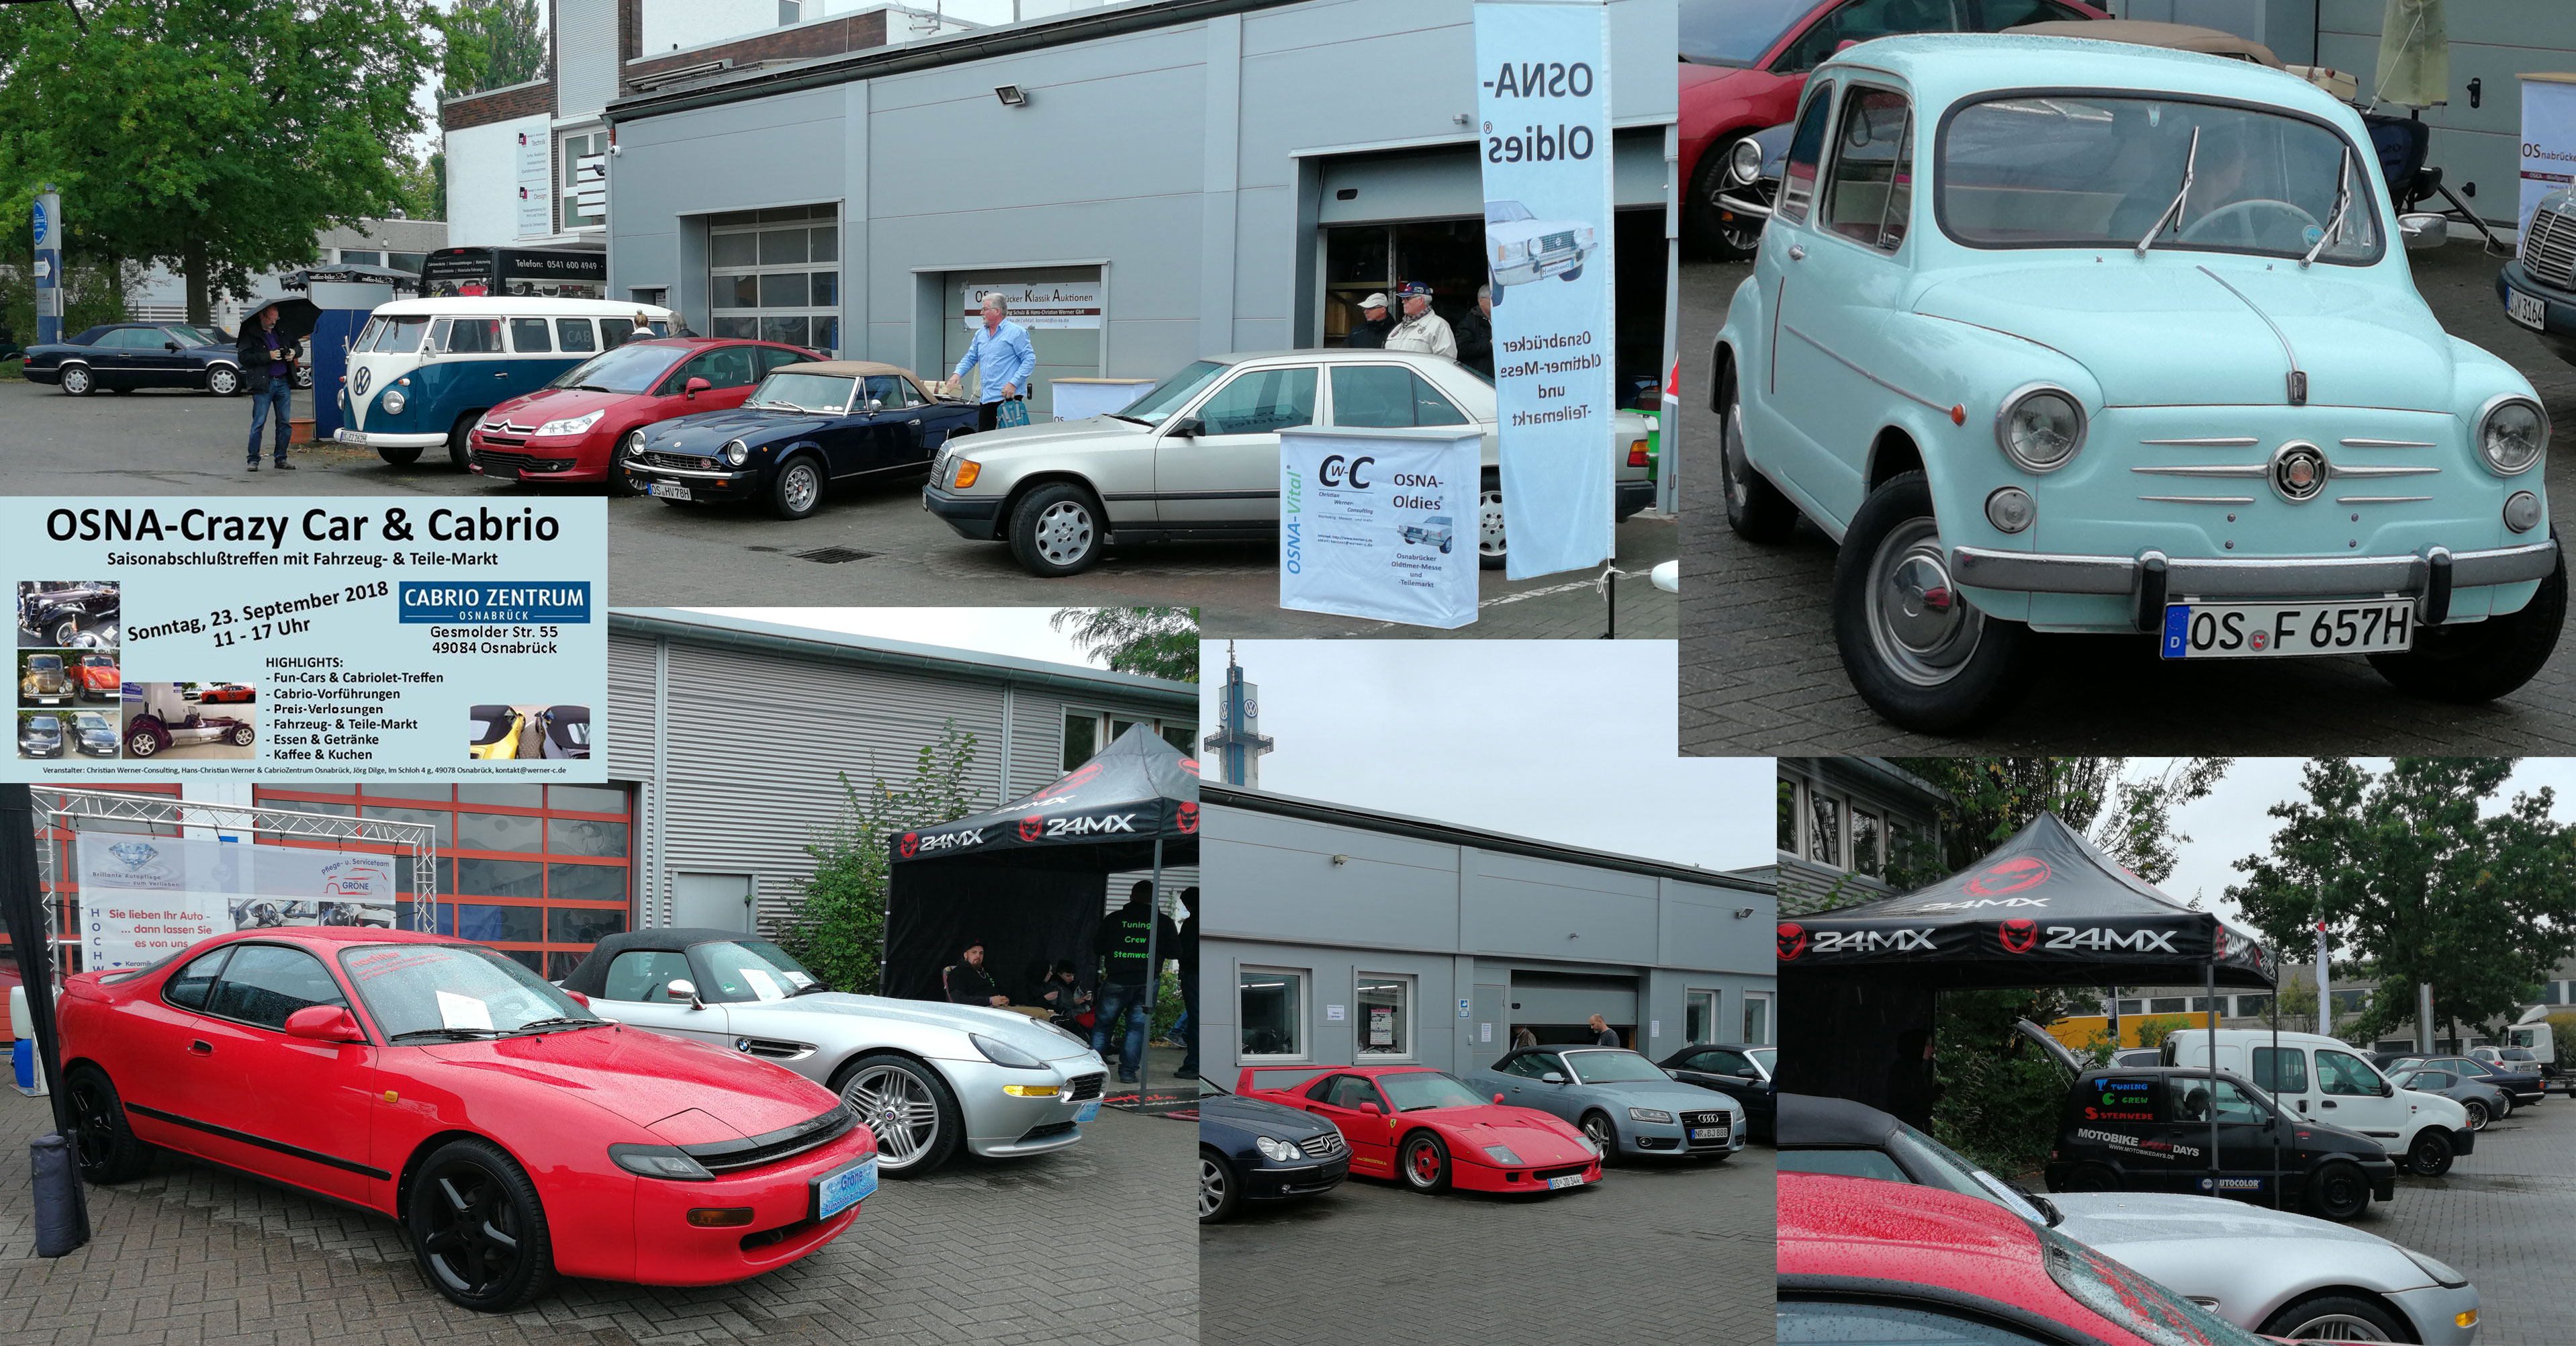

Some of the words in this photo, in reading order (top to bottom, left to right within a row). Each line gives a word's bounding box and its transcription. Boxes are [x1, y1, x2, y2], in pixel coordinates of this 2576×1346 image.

[515, 259, 543, 268] Telefon:
[547, 261, 564, 269] 0541
[566, 261, 579, 269] 600
[581, 262, 597, 270] 4949
[1025, 289, 1050, 303] Klassik
[1052, 289, 1093, 302] Auktionen
[2523, 298, 2543, 326] 3164
[355, 435, 367, 443] 262H
[1394, 474, 1444, 488] OSNA-
[651, 485, 661, 495] OS
[1396, 553, 1437, 562] Osnabrücker
[1391, 561, 1442, 571] Oldtimer-Messe
[2191, 612, 2245, 651] OS
[2274, 611, 2301, 649] F
[2310, 607, 2409, 647] 657H
[2170, 636, 2180, 649] D
[1046, 814, 1136, 836] 24MX
[919, 827, 984, 852] 24MX
[321, 862, 343, 875] Pflege-
[353, 858, 389, 868] Serviceteam
[125, 872, 161, 881] Autopflege
[342, 880, 369, 890] GRÖNE
[109, 909, 126, 919] Sie
[129, 909, 160, 919] lieben
[164, 910, 177, 920] Ihr
[180, 911, 203, 921] Auto
[134, 924, 160, 934] dann
[163, 924, 195, 934] lassen
[197, 925, 212, 934] Sie
[1121, 921, 1151, 930] Tuning
[150, 940, 168, 948] von
[1125, 936, 1147, 944] Crew
[1813, 928, 1937, 952] 24MX
[2045, 926, 2179, 953] 24MX
[350, 951, 401, 968] nachher
[2095, 1079, 2109, 1091] T
[2102, 1092, 2115, 1106] C
[2084, 1106, 2099, 1120] S
[2100, 1112, 2154, 1120] STEMWEDE
[1695, 1130, 1704, 1138] NR
[1707, 1129, 1715, 1137] BJ
[1716, 1128, 1727, 1136] 888
[2078, 1128, 2139, 1147] MOTOBIKE
[2172, 1144, 2200, 1157] DAYS
[2109, 1144, 2175, 1161] WWW.MOTOBIKEDAYS.DE
[841, 1170, 863, 1190] Gröne
[1552, 1179, 1560, 1188] OS
[1563, 1177, 1570, 1187] JD
[1569, 1176, 1580, 1185] 344
[2218, 1179, 2258, 1188] UTOCOLOR
[825, 1194, 849, 1213] Autopflege
[850, 1191, 860, 1200] zum
[860, 1181, 876, 1196] Verlieben
